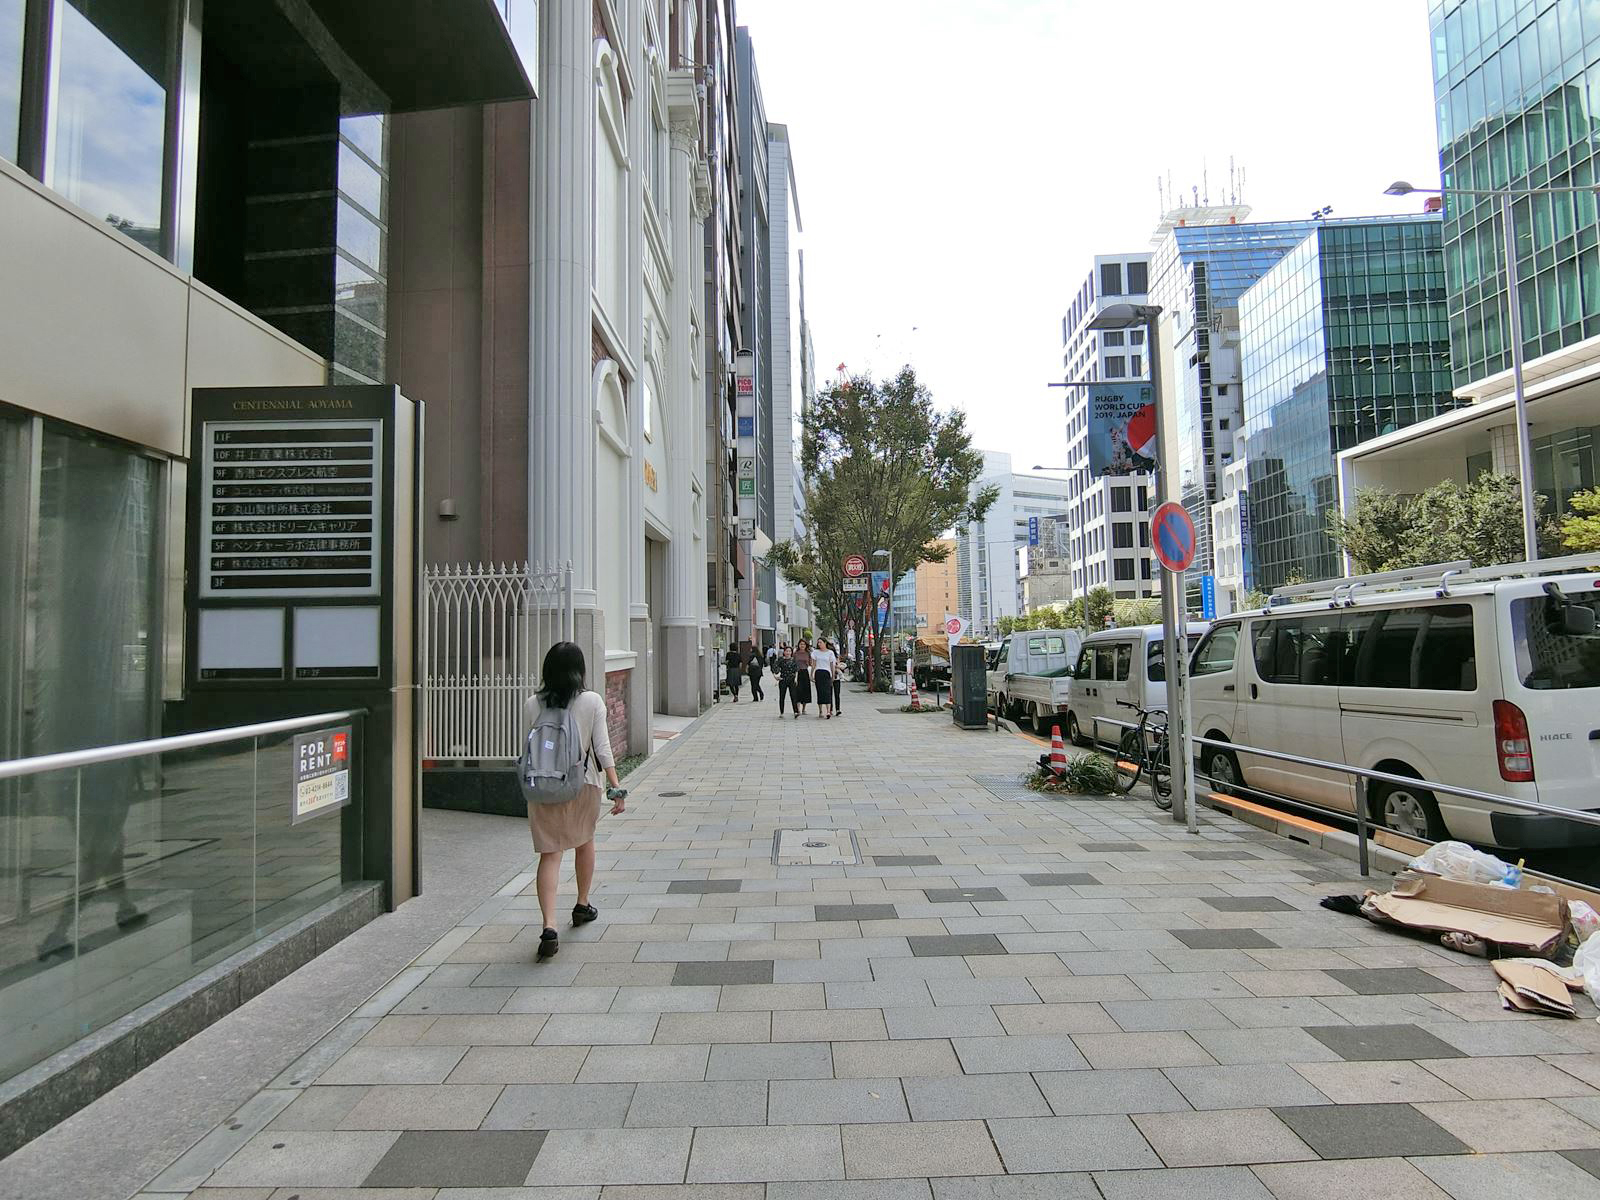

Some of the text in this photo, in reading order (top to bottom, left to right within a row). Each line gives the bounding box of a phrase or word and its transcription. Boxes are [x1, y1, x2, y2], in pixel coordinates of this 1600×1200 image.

[233, 399, 353, 410] CENTENNIAL AOYAMA
[1127, 402, 1145, 410] CUP
[1116, 411, 1145, 419] JAPAN
[215, 432, 231, 441] 11F
[215, 450, 231, 459] 10F
[215, 467, 337, 478] 9F 香港エクスプレス航空
[215, 487, 226, 496] 8F
[215, 504, 226, 513] 7F
[215, 521, 358, 532] 6F 株式会社ドリームキャリア
[215, 542, 225, 550] 5F
[214, 560, 225, 569] 4F
[214, 578, 225, 587] 3F
[1540, 733, 1573, 741] HIACE
[301, 741, 324, 758] FOR
[300, 753, 332, 772] RENT
